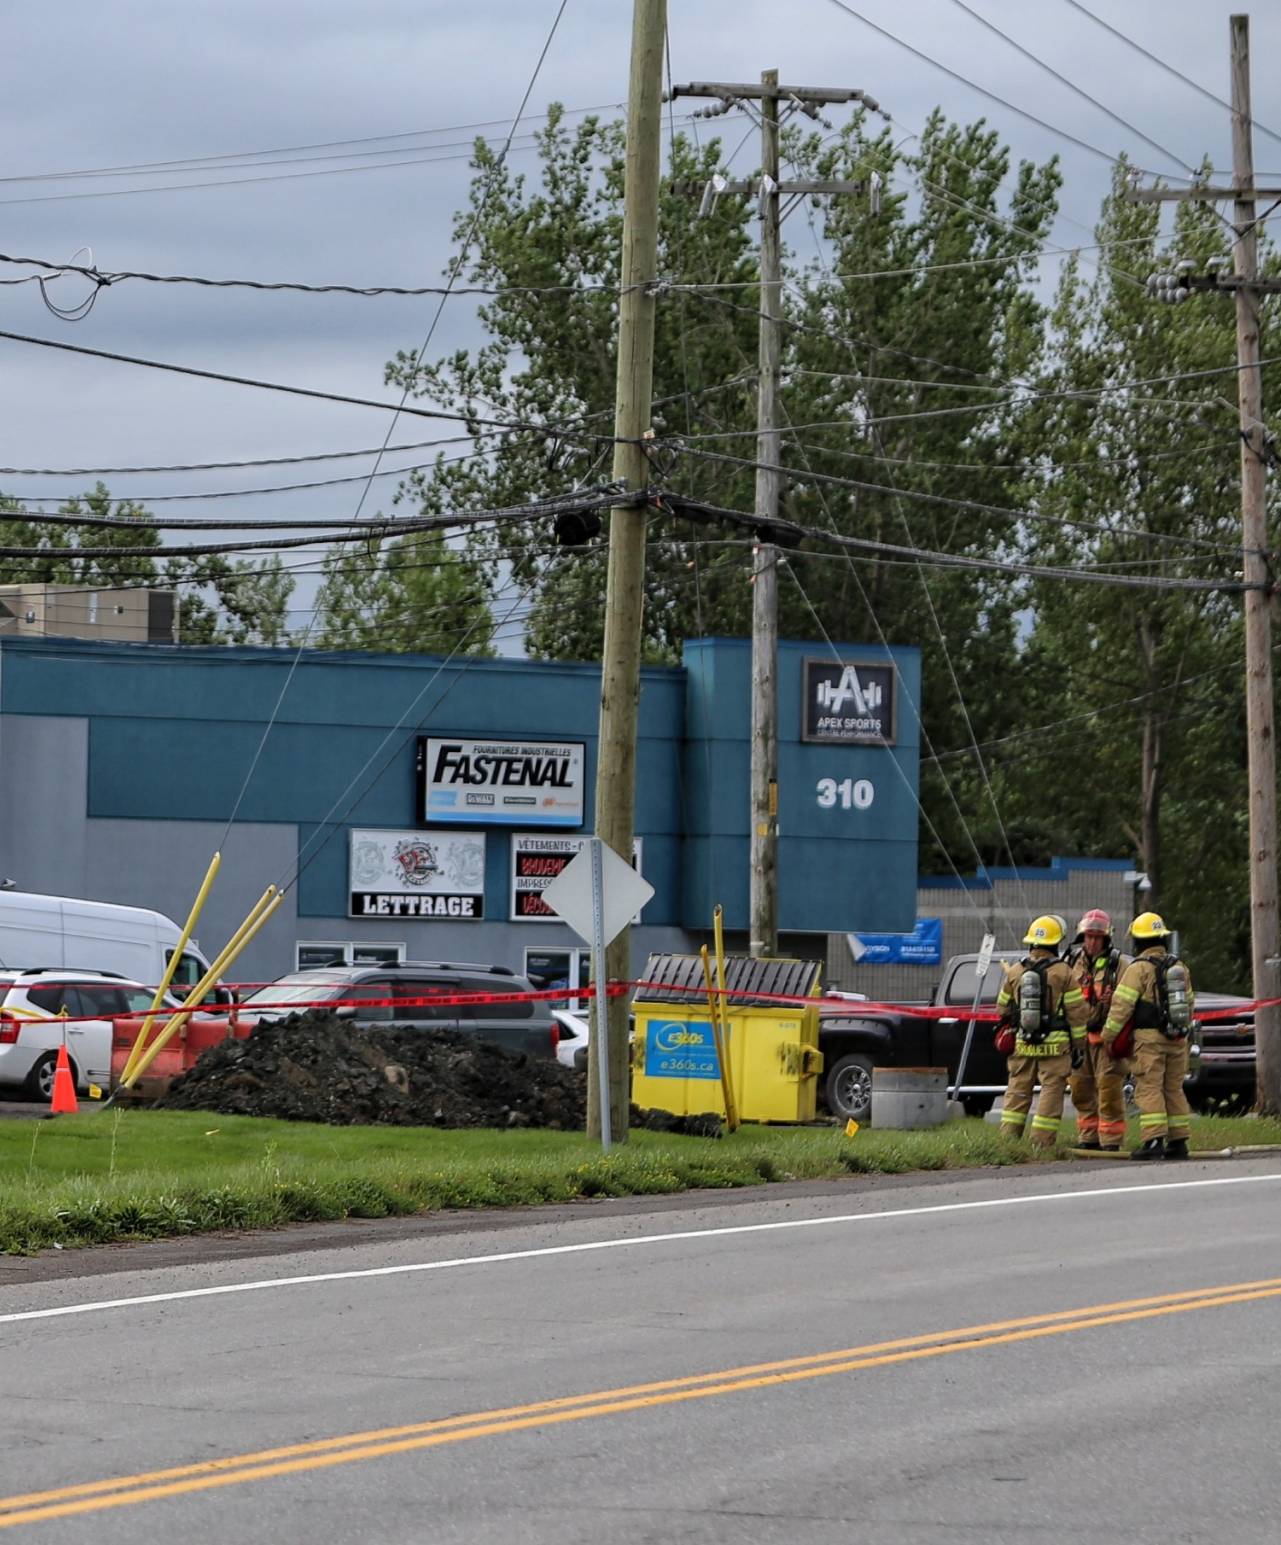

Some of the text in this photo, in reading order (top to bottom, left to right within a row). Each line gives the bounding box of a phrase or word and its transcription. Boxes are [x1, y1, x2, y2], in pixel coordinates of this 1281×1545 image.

[817, 718, 881, 729] APEX SPORTS
[473, 745, 571, 757] FOURNITURES INDUSTRIELLES
[816, 778, 874, 809] 310
[519, 838, 571, 850] VÊTEMENTS
[363, 895, 474, 916] LETTRAGE
[660, 1058, 714, 1072] e360s.ca
